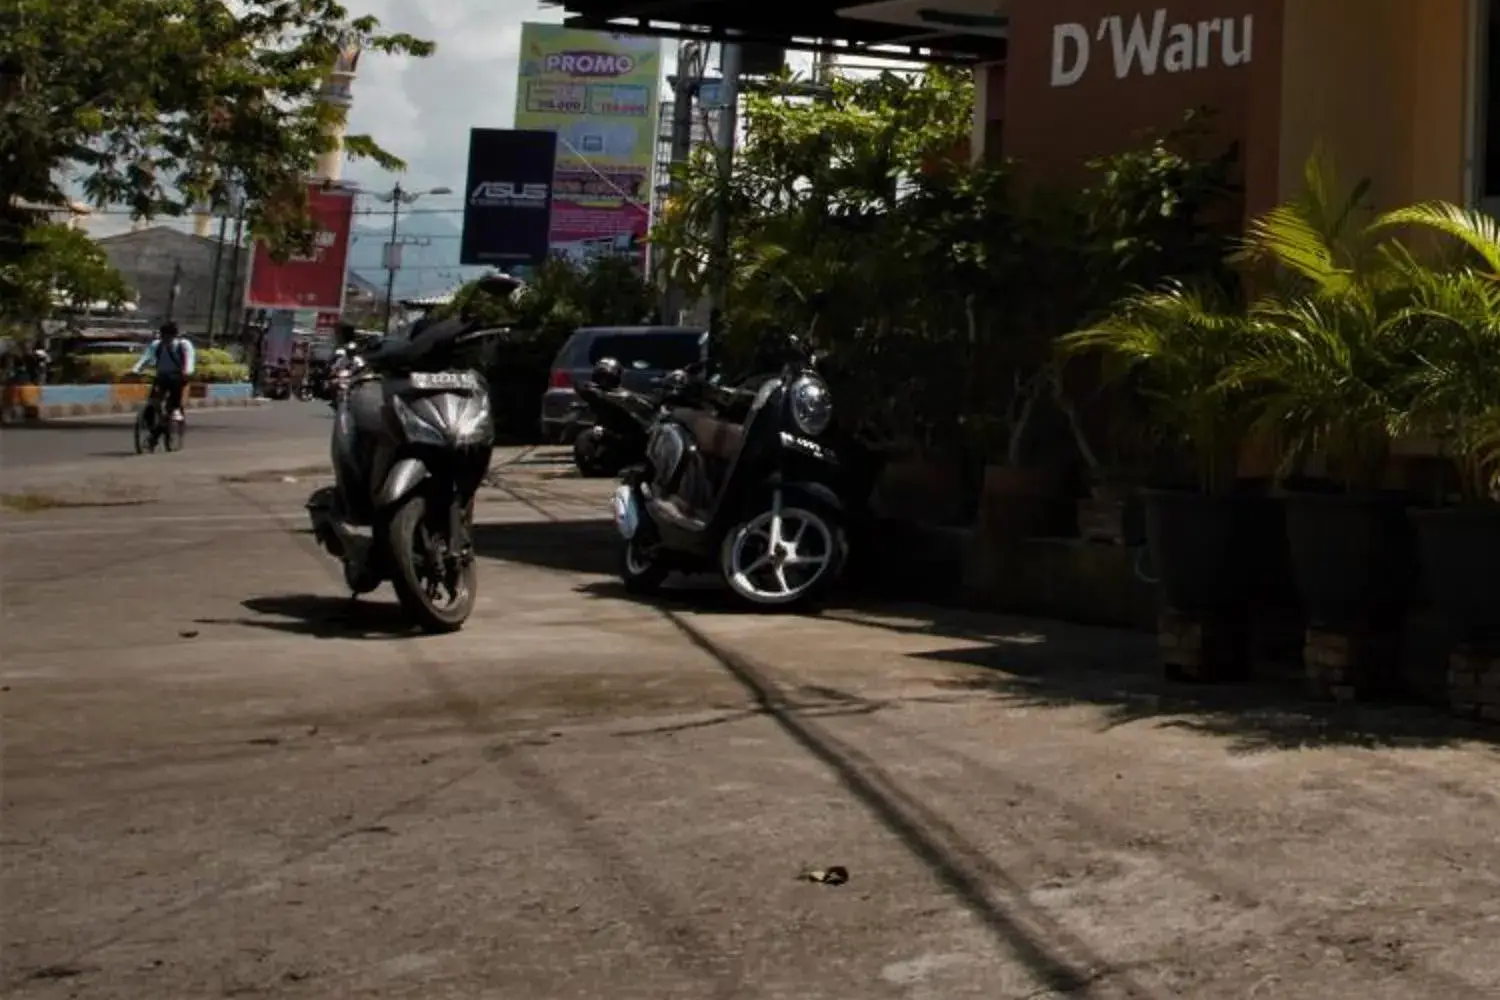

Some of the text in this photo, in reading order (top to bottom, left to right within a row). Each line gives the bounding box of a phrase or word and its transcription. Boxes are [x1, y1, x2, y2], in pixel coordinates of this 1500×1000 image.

[1050, 8, 1254, 87] D'Waru
[546, 54, 634, 74] PROMO
[471, 181, 549, 199] ASUS
